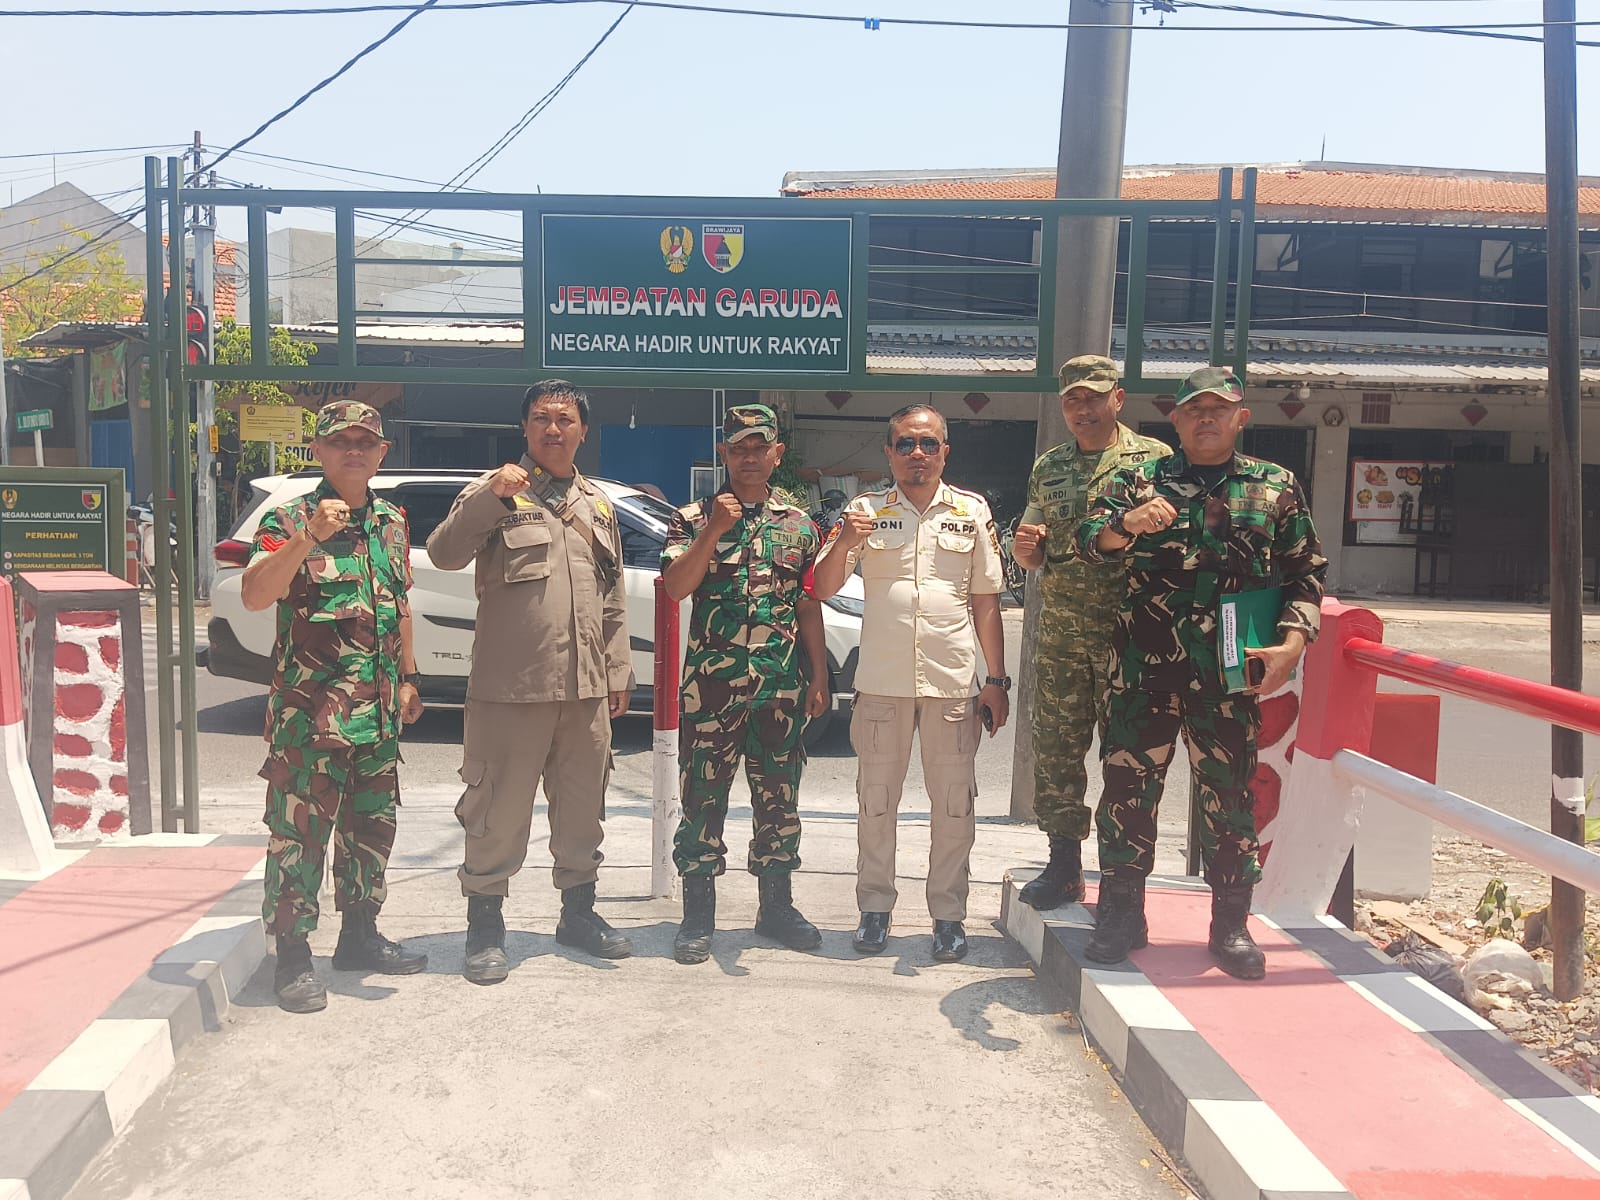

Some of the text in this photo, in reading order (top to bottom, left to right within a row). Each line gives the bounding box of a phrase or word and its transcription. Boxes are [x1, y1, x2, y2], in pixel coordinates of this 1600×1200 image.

[549, 285, 844, 319] JEMBATAN GARUDA
[550, 332, 841, 356] NEGARA HADIR UNTUK RAKYAT
[2, 511, 30, 519] NEGARA
[76, 512, 102, 520] RAKYAT
[940, 522, 975, 535] POL PP
[25, 532, 78, 540] PERHATIAN!
[775, 532, 808, 546] TNI AD
[432, 651, 465, 661] TRD
